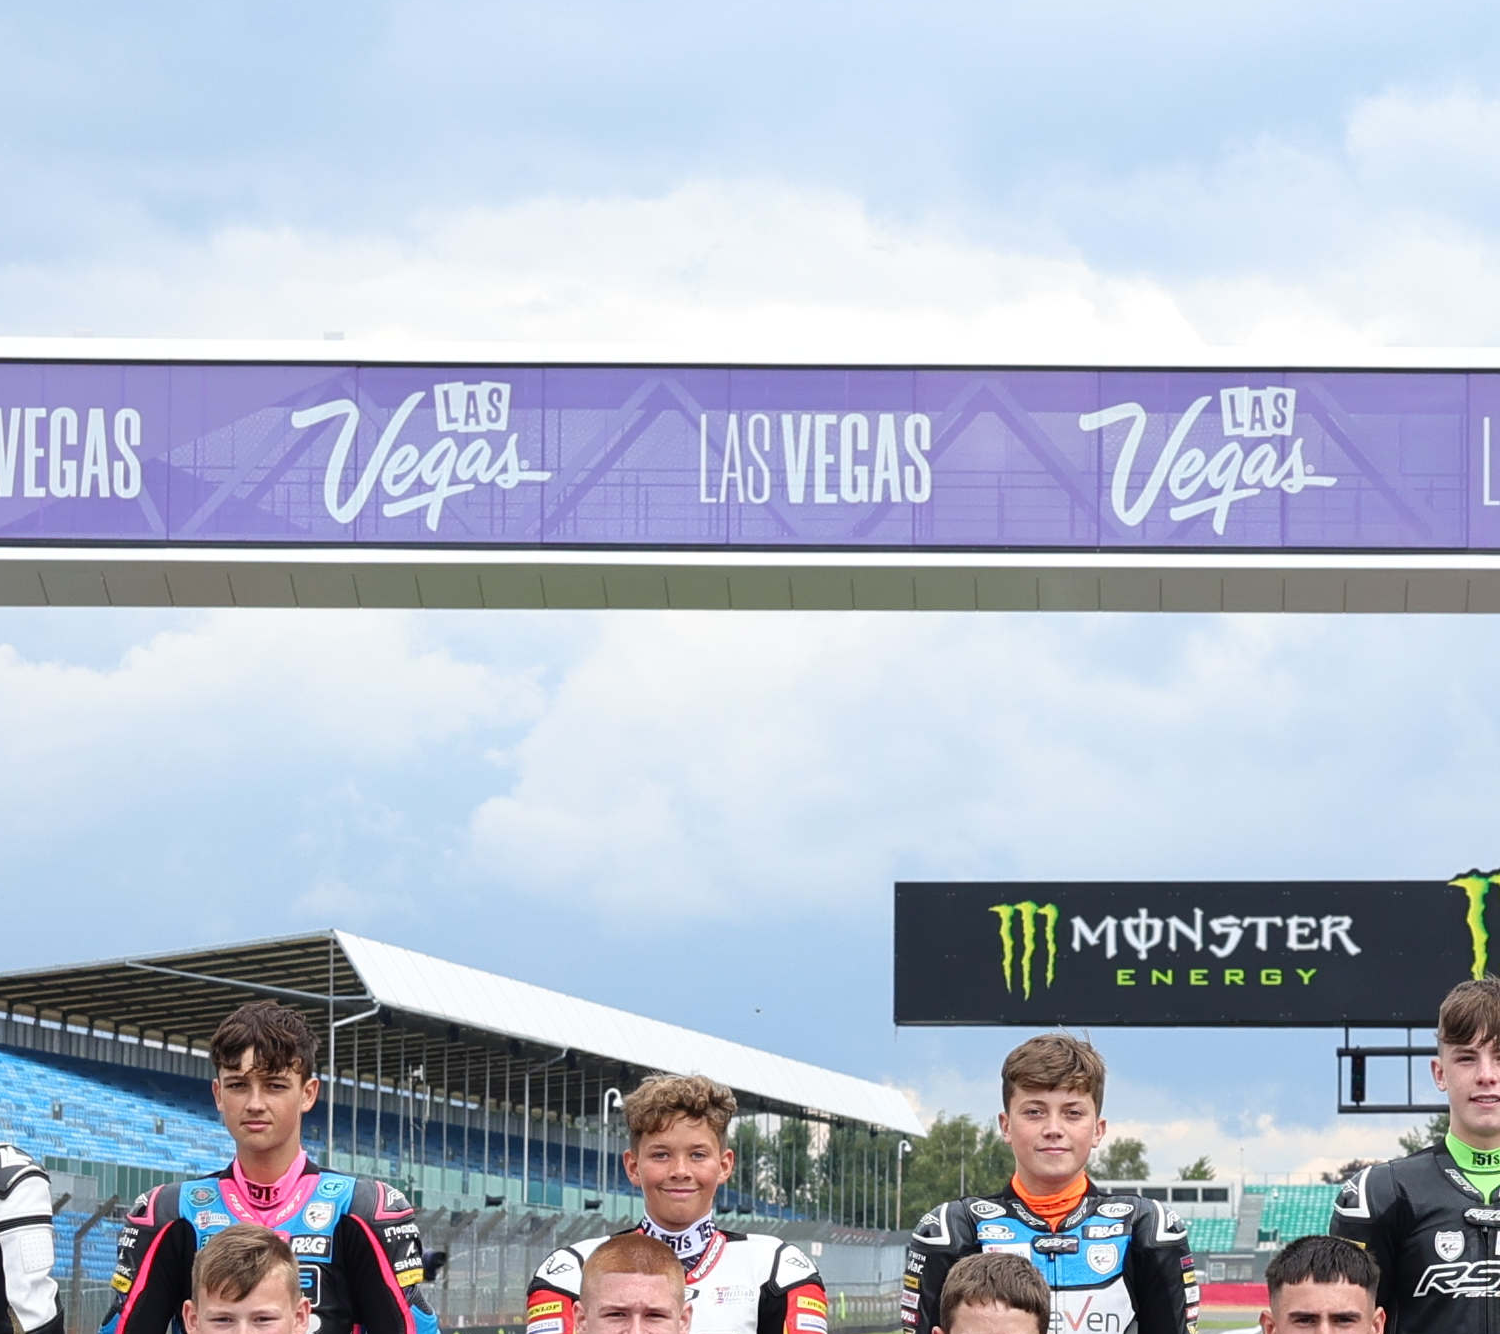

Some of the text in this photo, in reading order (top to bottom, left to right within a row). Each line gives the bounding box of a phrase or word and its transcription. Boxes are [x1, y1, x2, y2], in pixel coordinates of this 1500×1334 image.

[437, 385, 508, 430] LAS
[1223, 390, 1295, 434] LAS
[293, 391, 550, 531] Vegas
[701, 412, 931, 504] LAS VEGAS
[1079, 395, 1336, 535] Vegas
[1071, 909, 1361, 959] MONSTER
[1117, 969, 1318, 986] ENERGY
